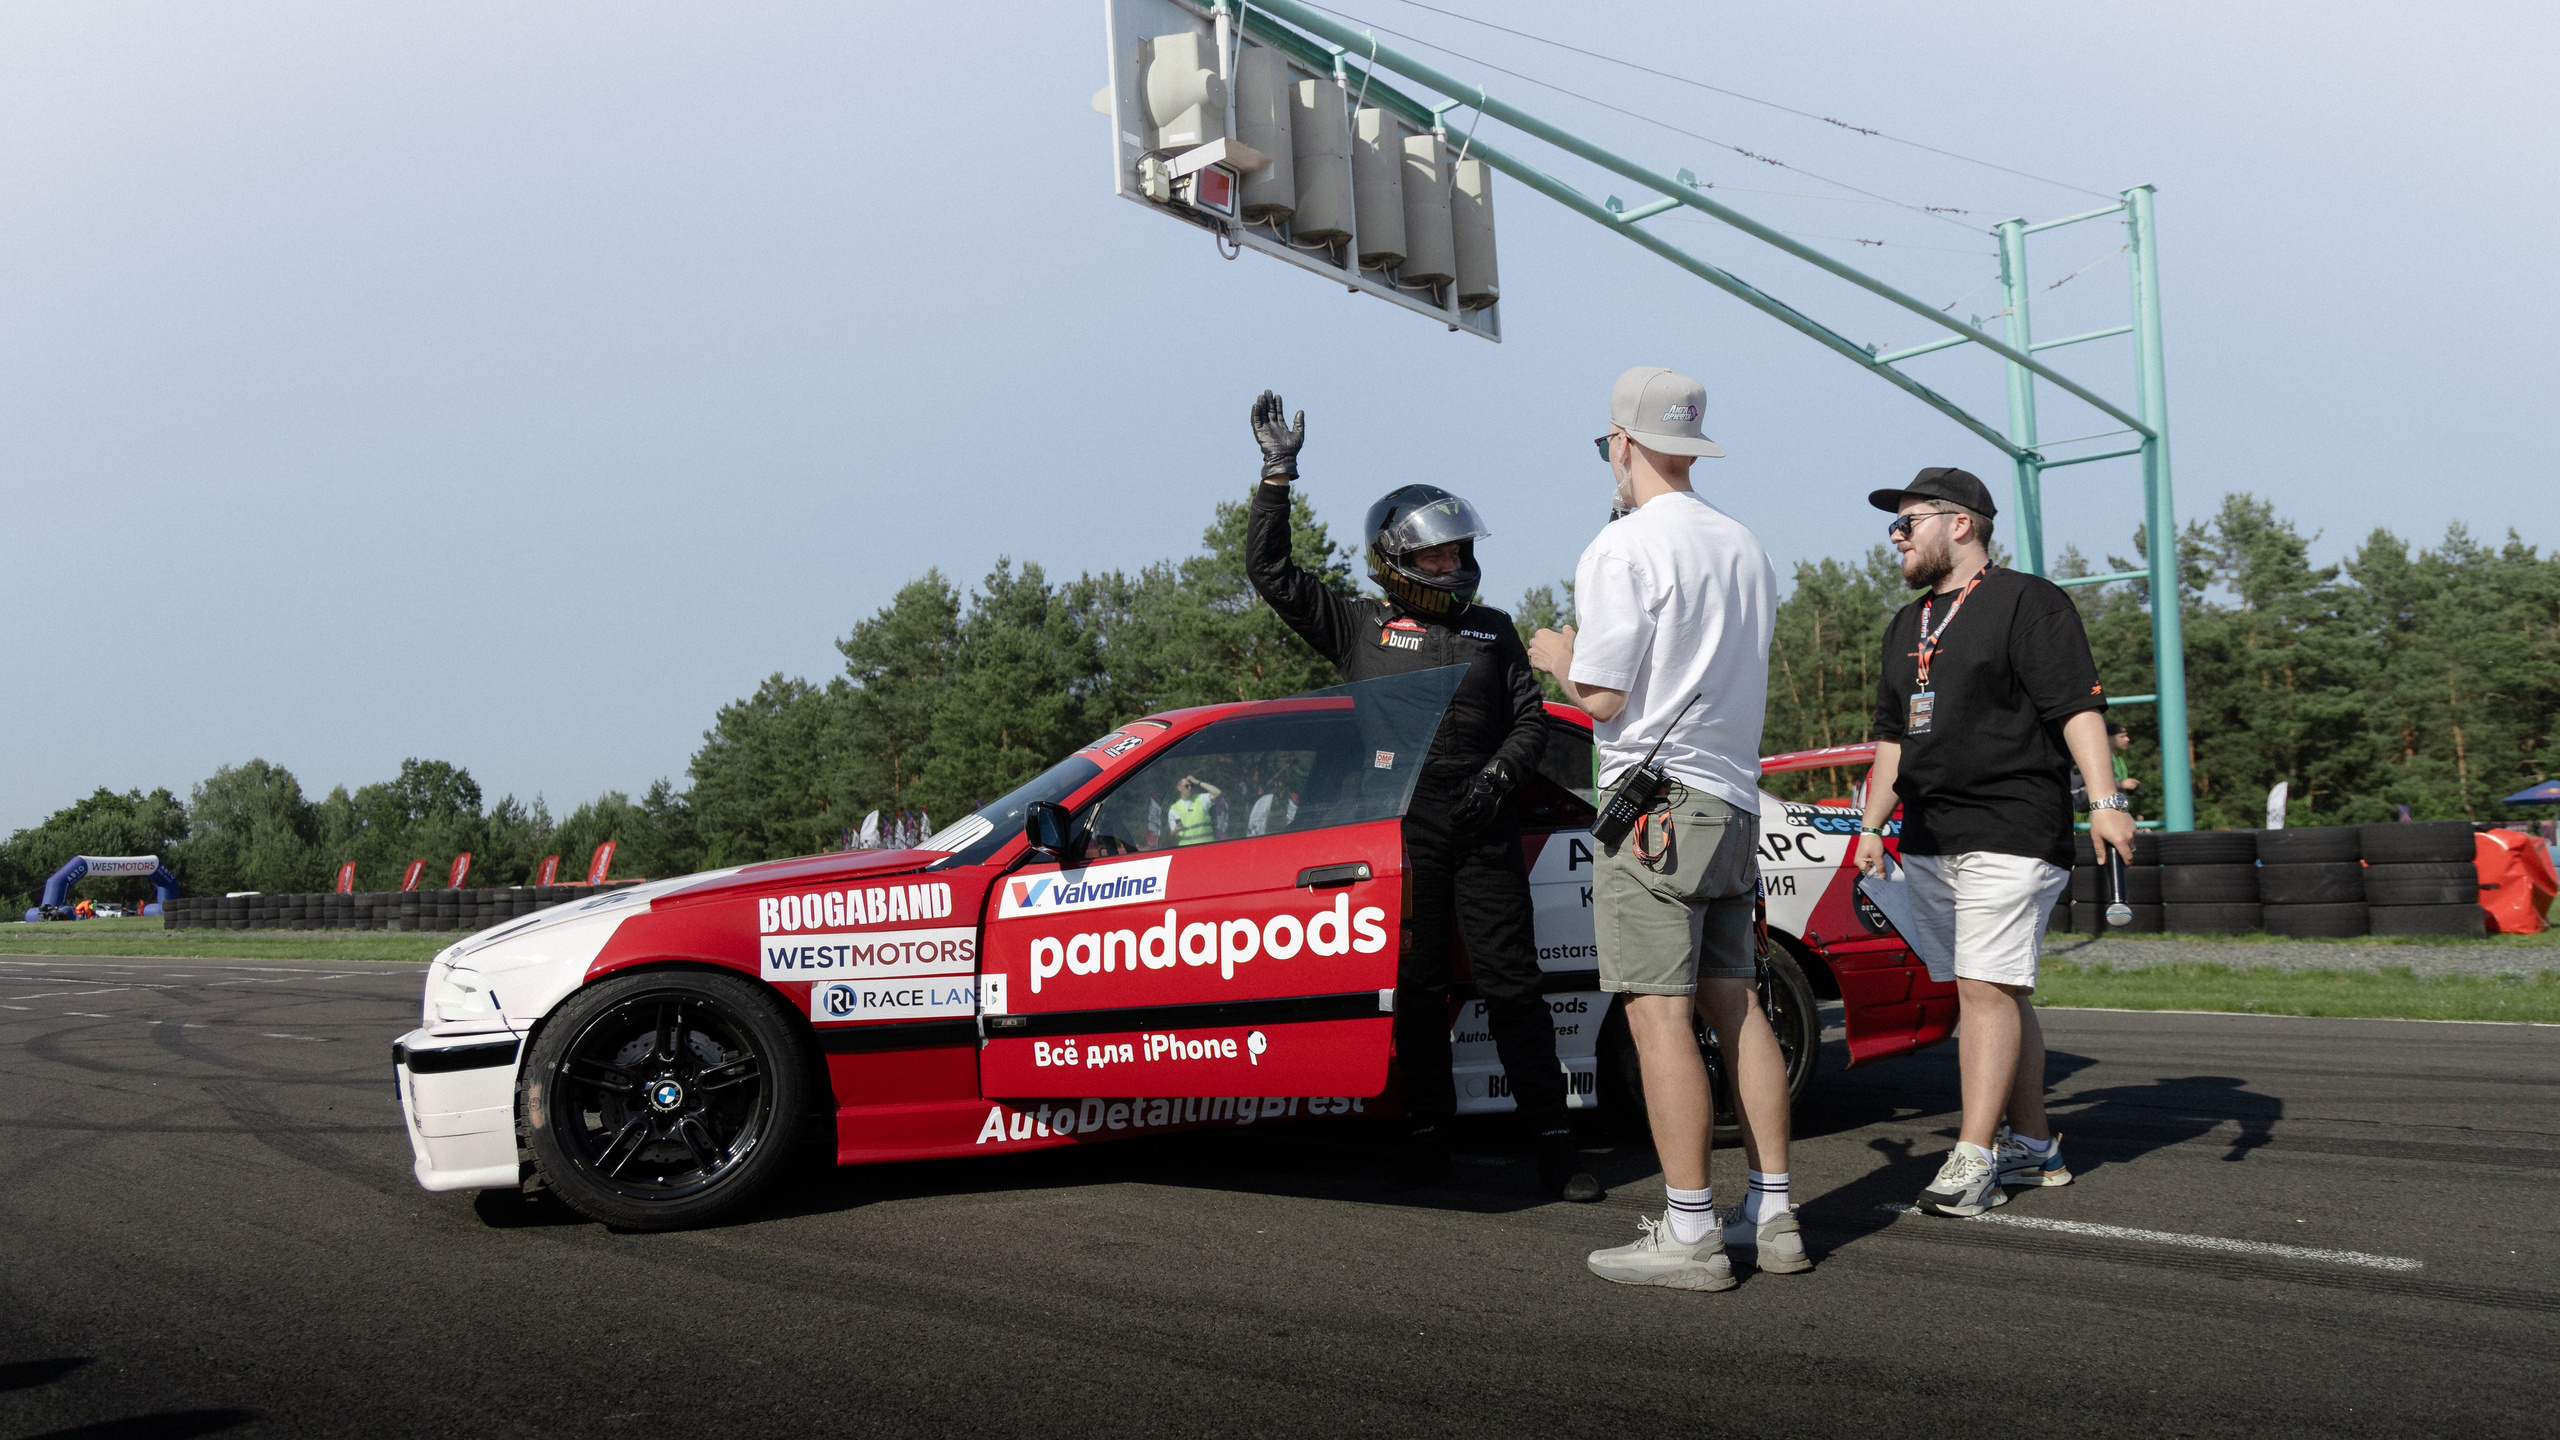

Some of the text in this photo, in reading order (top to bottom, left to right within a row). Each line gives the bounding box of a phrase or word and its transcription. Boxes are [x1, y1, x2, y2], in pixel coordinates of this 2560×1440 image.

[1389, 631, 1419, 650] burn
[1377, 754, 1392, 762] OMP
[1816, 806, 1865, 816] ШИН
[92, 862, 156, 871] WESTMOTORS
[1053, 874, 1157, 906] Valvoline
[759, 883, 952, 933] BOOGABAND
[1030, 892, 1388, 994] pandapods
[1539, 944, 1598, 960] astars
[768, 939, 975, 969] WESTMOTORS
[863, 989, 924, 1008] RACE
[1034, 1033, 1238, 1069] Всё для iPhone
